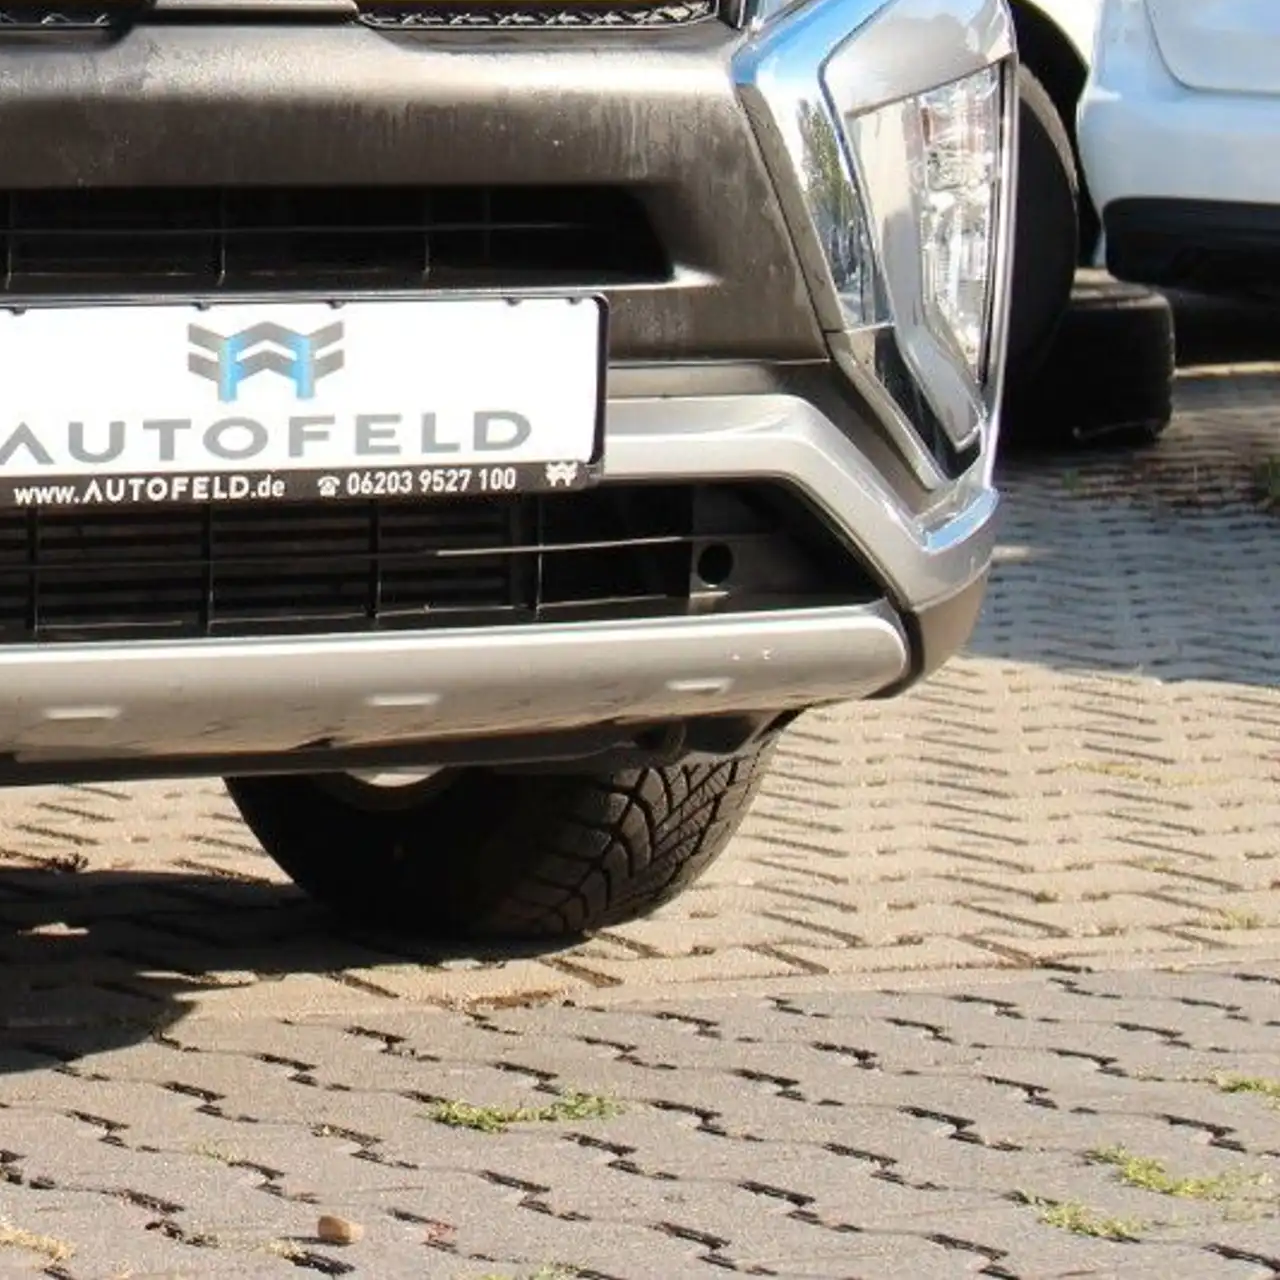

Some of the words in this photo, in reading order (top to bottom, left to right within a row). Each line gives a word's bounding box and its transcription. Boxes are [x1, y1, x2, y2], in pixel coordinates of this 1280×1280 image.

[13, 474, 286, 505] www.AUTOFELD.de
[346, 472, 413, 496] 06203
[418, 469, 472, 494] 9527
[478, 467, 517, 491] 100
